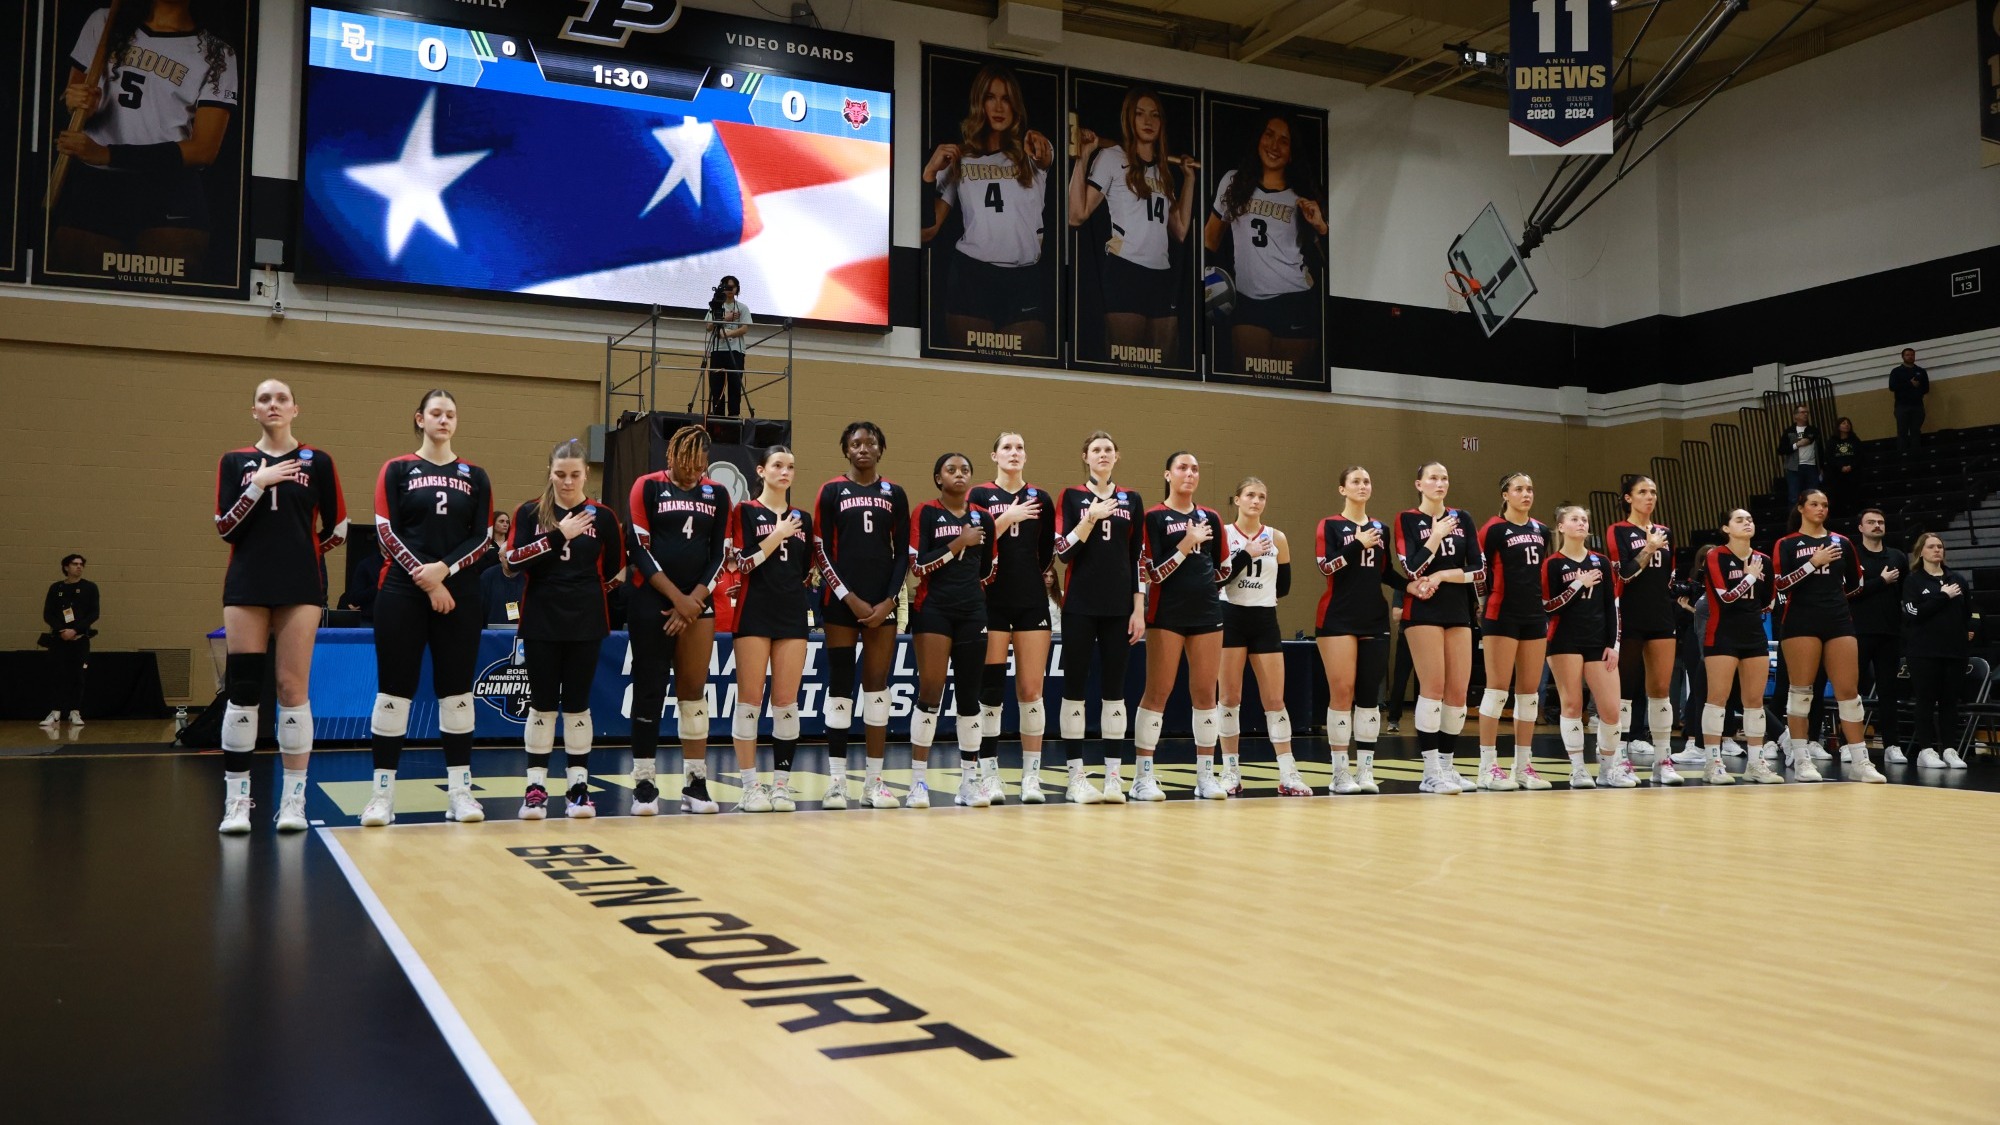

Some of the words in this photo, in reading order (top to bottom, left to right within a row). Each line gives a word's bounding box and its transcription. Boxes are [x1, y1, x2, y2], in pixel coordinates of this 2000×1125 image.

[1532, 0, 1589, 53] 11
[418, 38, 448, 72] 0
[502, 41, 516, 56] 0
[725, 32, 779, 51] VIDEO
[786, 42, 855, 63] BOARDS
[112, 46, 189, 87] RDUE
[592, 65, 649, 90] 1:30
[1515, 65, 1606, 90] DREWS
[118, 70, 146, 109] 5
[720, 73, 734, 88] 0
[781, 90, 807, 121] 0
[1526, 108, 1556, 120] 2020
[1564, 107, 1595, 119] 2024
[984, 182, 1004, 213] 4
[1146, 196, 1165, 224] 14
[1246, 199, 1294, 224] RDUE
[1251, 218, 1268, 248] 3
[102, 252, 185, 277] PURDUE
[118, 275, 169, 284] VOLLEYBALL
[1960, 281, 1973, 291] 13
[967, 330, 1022, 351] PURDUE
[1111, 344, 1162, 364] PURDUE
[1245, 356, 1293, 375] PURDUE
[1461, 436, 1479, 451] EXIT
[408, 475, 448, 491] ARKANSAS
[449, 477, 472, 496] STATE
[269, 486, 279, 511] 1
[435, 491, 448, 515] 2
[657, 500, 694, 514] ARKANSAS
[696, 502, 717, 517] STATE
[840, 496, 873, 513] ARKANSAS
[874, 497, 893, 513] STATE
[682, 515, 694, 540] 4
[863, 510, 874, 534] 6
[1101, 519, 1112, 541] 9
[779, 540, 789, 562] 5
[1360, 547, 1375, 568] 12
[1440, 537, 1456, 557] 13
[1525, 545, 1539, 565] 15
[1237, 578, 1263, 590] State
[505, 844, 703, 908] BELIN
[617, 911, 1017, 1061] COURT
